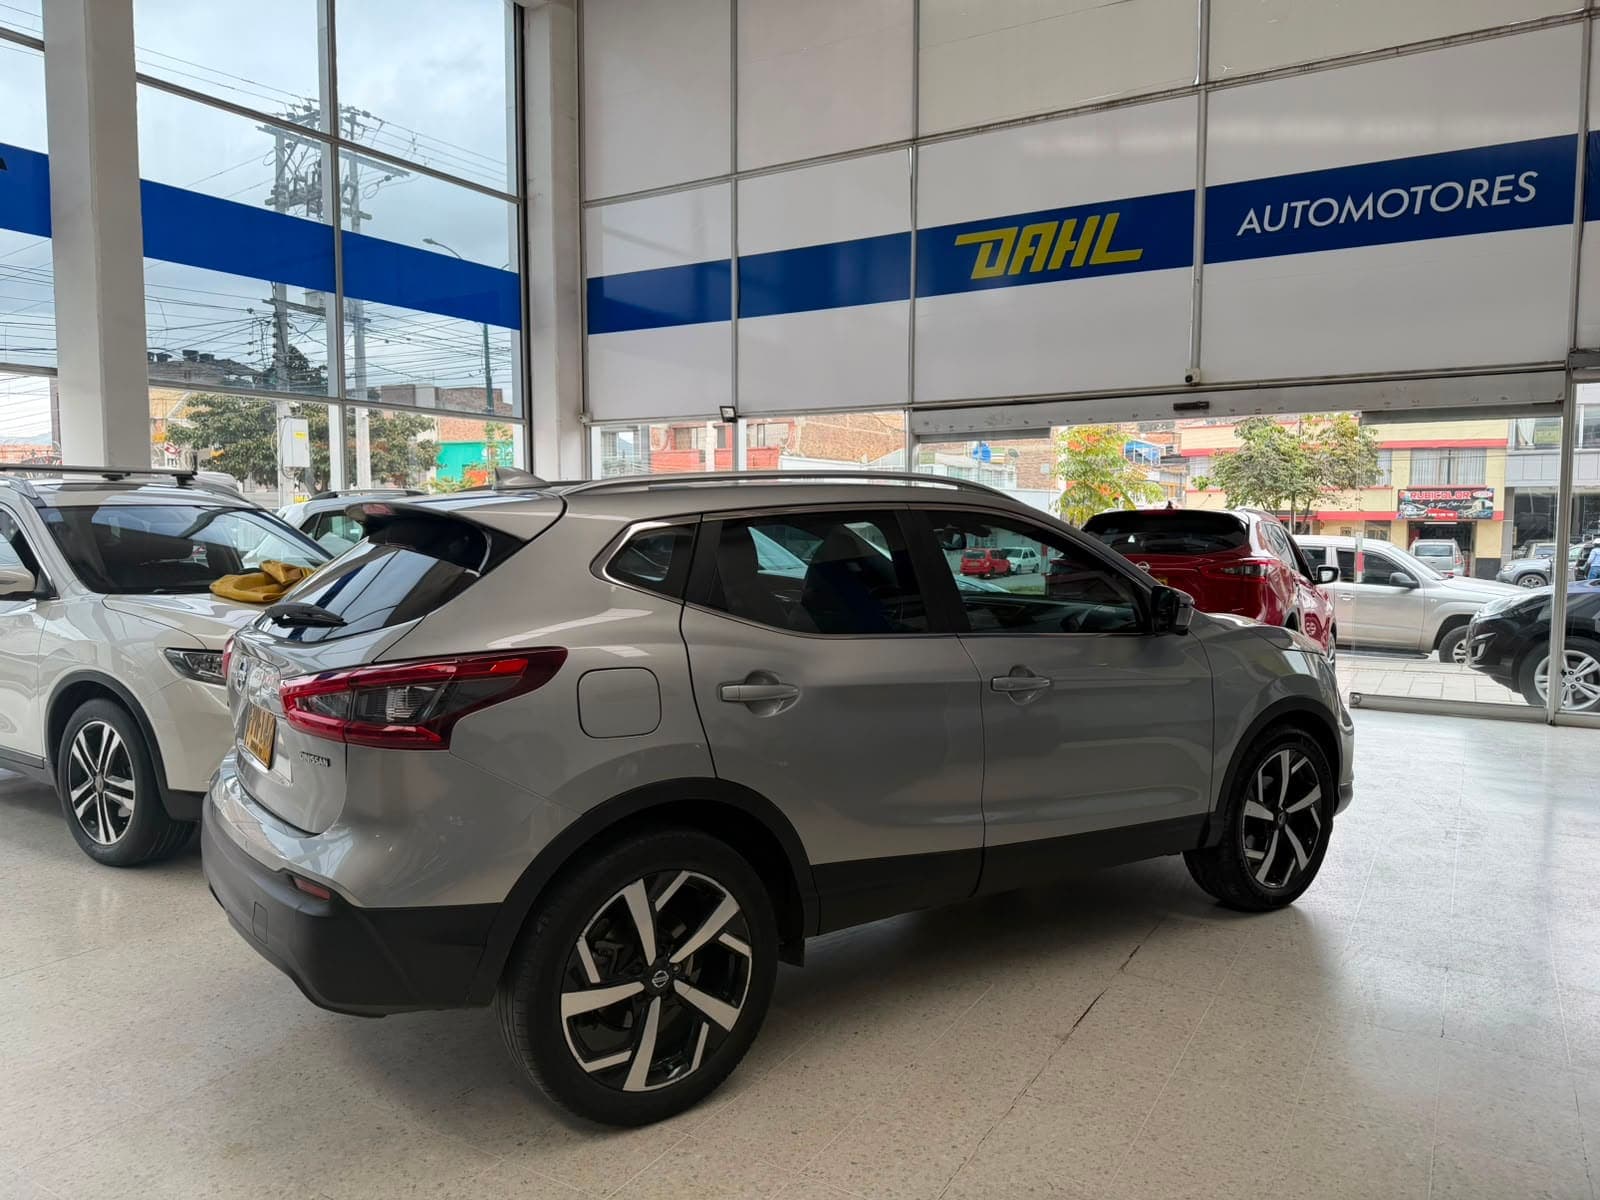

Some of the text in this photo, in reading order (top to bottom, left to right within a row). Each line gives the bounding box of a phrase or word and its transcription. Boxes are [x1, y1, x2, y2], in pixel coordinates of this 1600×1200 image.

[954, 170, 1539, 280] DAHL AUTOMOTORES
[1410, 490, 1472, 500] RUBICOLOR
